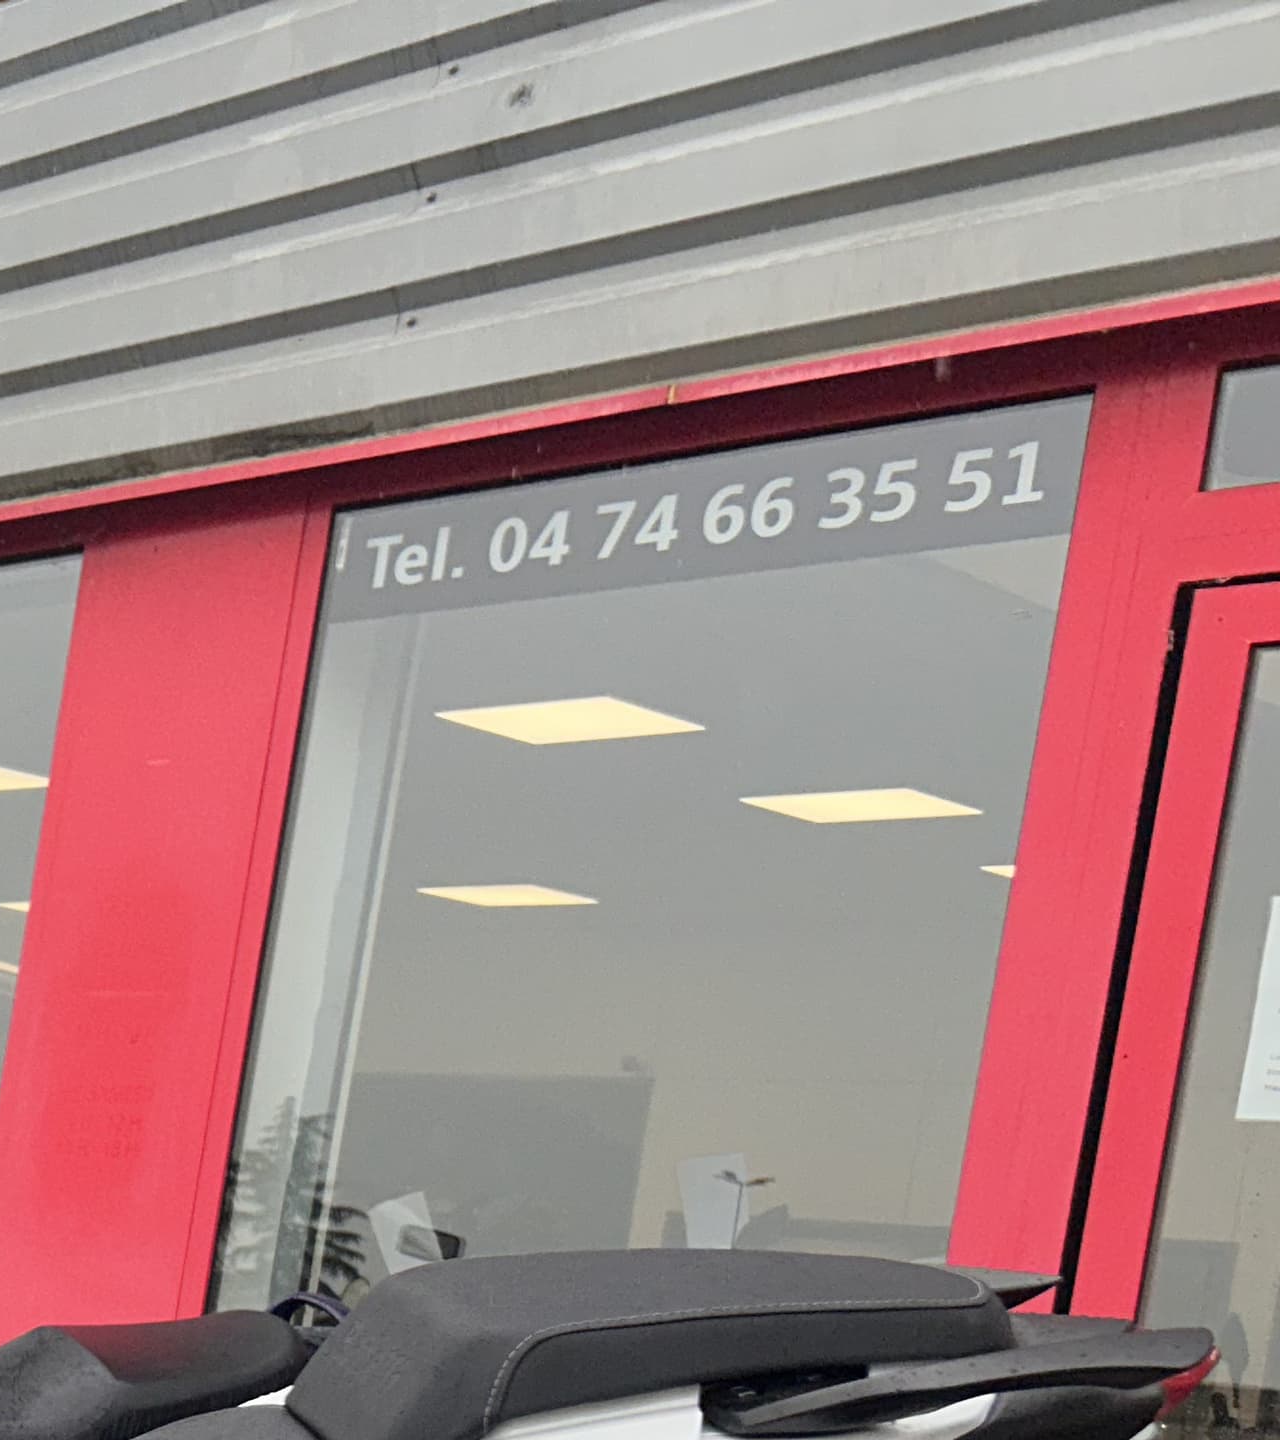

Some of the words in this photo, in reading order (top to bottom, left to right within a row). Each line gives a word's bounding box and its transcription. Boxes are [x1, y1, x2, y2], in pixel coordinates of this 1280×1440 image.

[366, 526, 465, 590] Tel.
[487, 510, 571, 574] 04
[596, 493, 680, 560] 74
[702, 476, 795, 546] 66
[817, 458, 918, 530] 35
[944, 440, 1045, 513] 51
